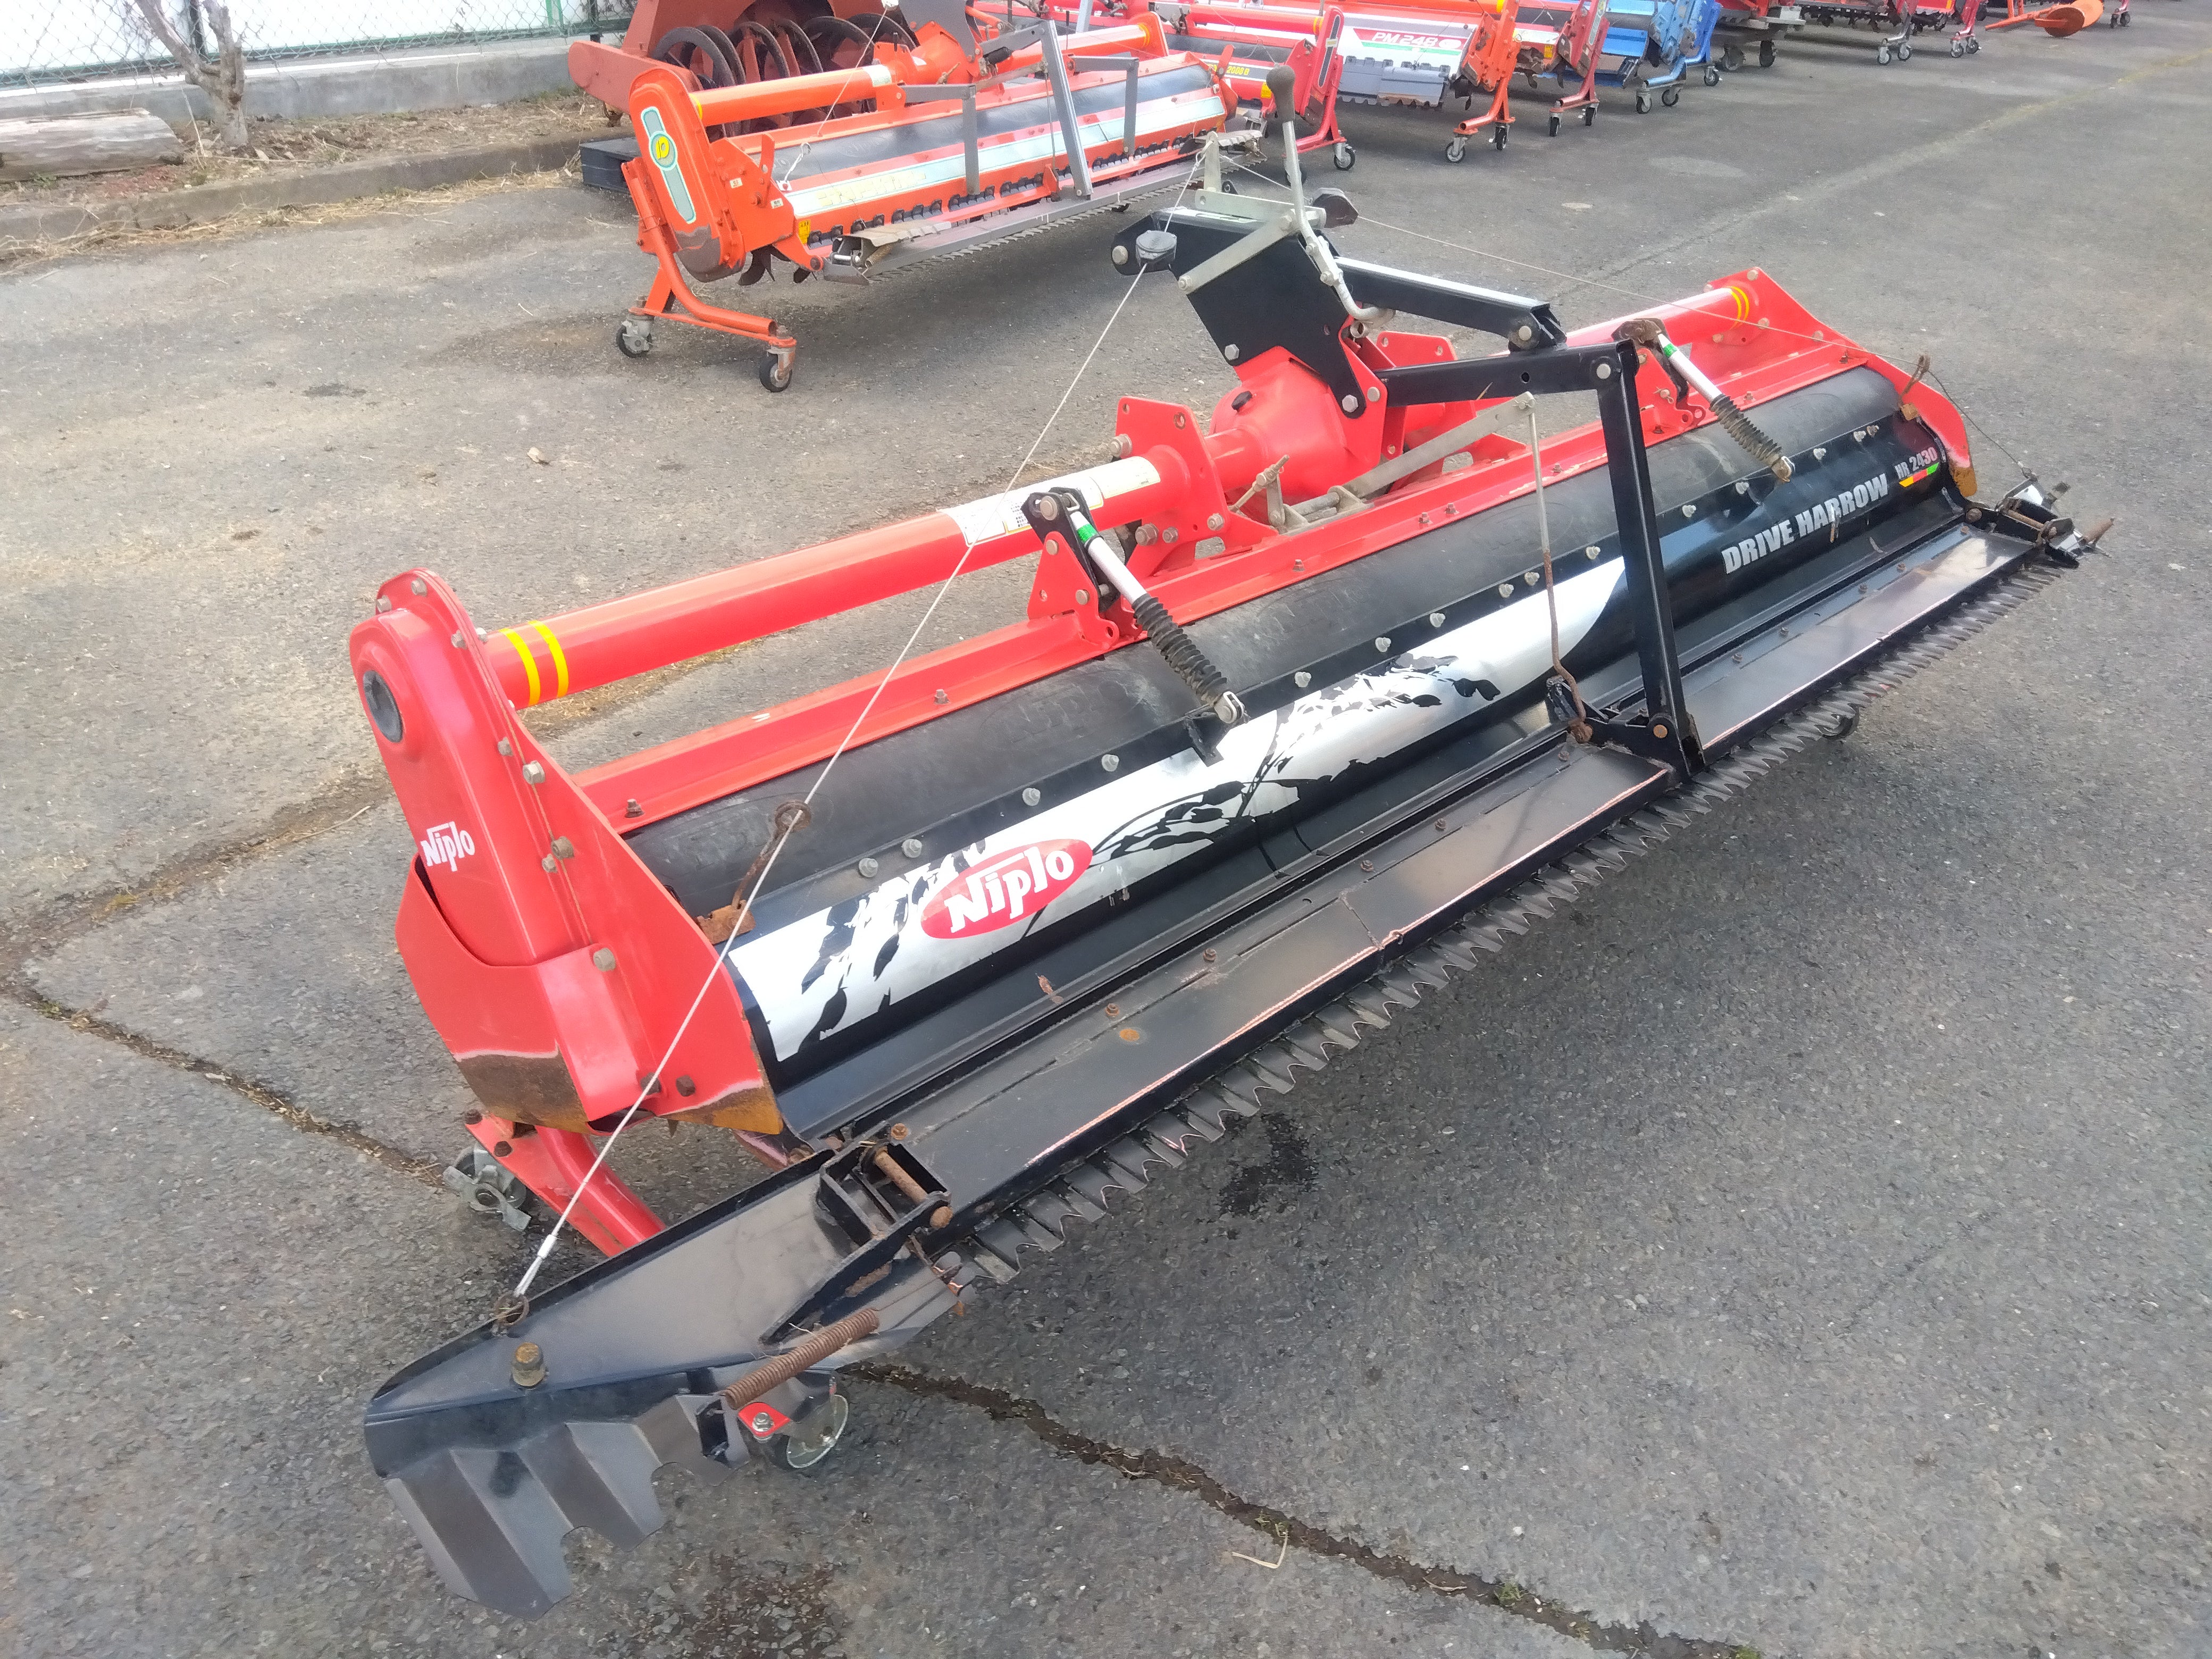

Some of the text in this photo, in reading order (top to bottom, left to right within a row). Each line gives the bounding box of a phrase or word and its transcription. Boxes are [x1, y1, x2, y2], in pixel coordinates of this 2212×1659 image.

[1372, 32, 1400, 44] PM
[1400, 35, 1438, 47] 248
[1894, 447, 1938, 479] HR 2430
[1721, 473, 1888, 574] DRIVE HARROW
[420, 820, 475, 872] Niplo
[944, 846, 1074, 934] Niplo
